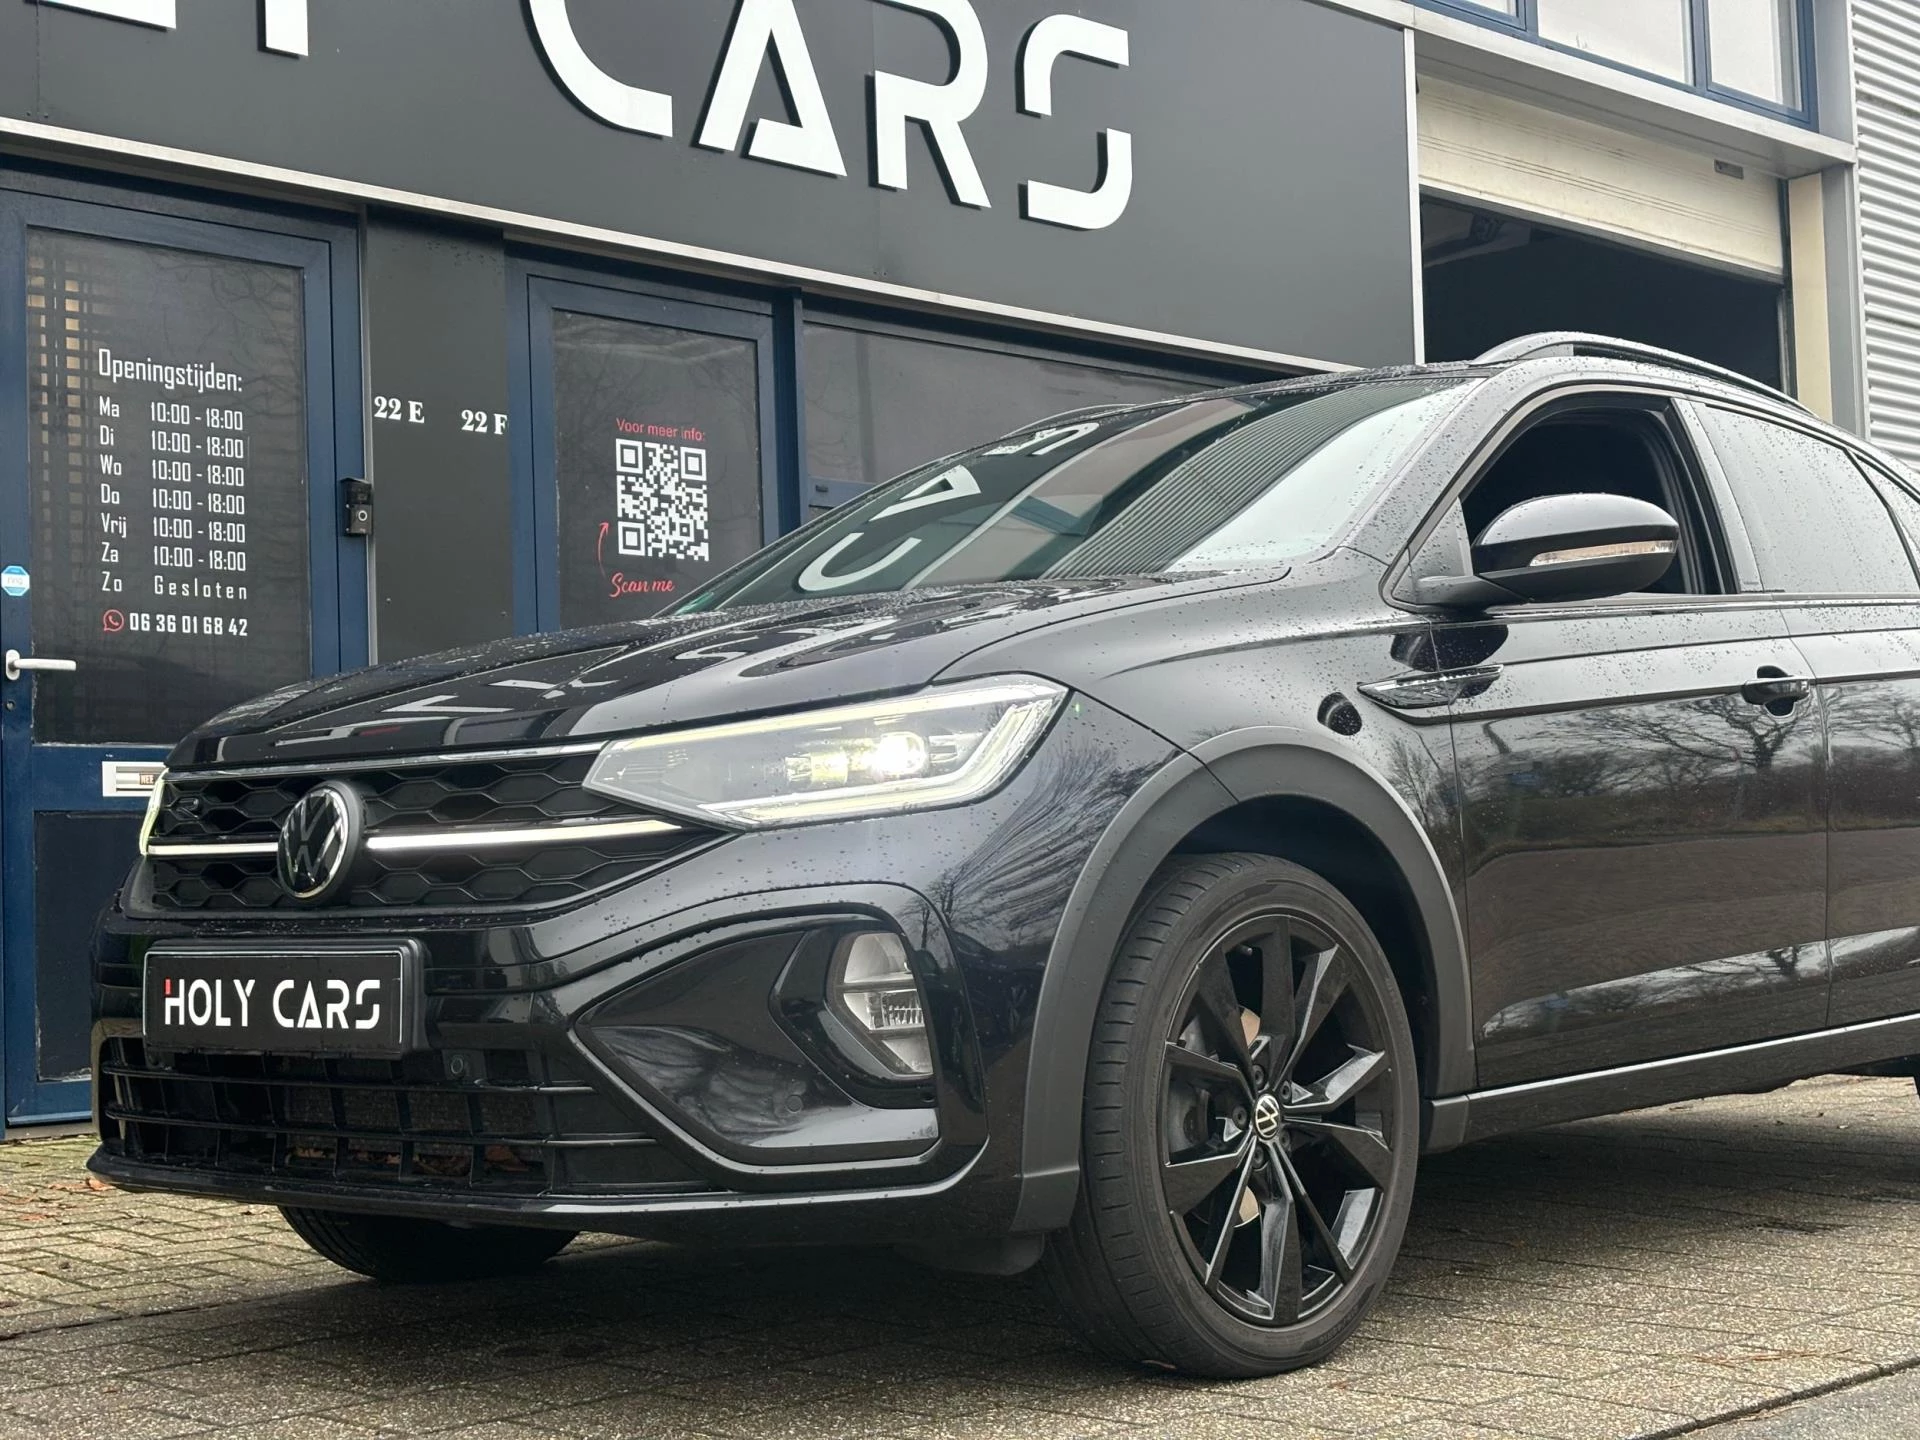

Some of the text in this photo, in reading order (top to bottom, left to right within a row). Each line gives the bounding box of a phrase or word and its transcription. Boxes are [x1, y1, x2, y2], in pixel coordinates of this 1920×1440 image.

[99, 348, 243, 393] Openingstijden:
[100, 396, 120, 418] Ma
[151, 402, 190, 425] 10:00
[206, 408, 243, 431] 18:00
[374, 395, 425, 424] 22 E
[461, 409, 508, 435] 22 F
[100, 425, 114, 446] Di
[152, 430, 191, 453] 10:00
[207, 436, 244, 459] 18:00
[616, 417, 644, 433] Voor
[647, 424, 678, 437] meer
[100, 454, 122, 476] Wo
[152, 459, 191, 482] 10:00
[207, 465, 244, 487] 18:00
[101, 483, 120, 504] Do
[153, 488, 192, 511] 10:00
[208, 493, 245, 515] 18:00
[101, 512, 127, 538] Vrij
[153, 517, 192, 539] 10:00
[209, 521, 246, 543] 18:00
[101, 542, 119, 562] Za
[154, 545, 193, 568] 10:00
[209, 550, 246, 572] 18:00
[102, 571, 247, 599] Zo Gesloten
[609, 572, 675, 598] Scan me
[129, 613, 248, 636] 06 36 01 68 42
[164, 978, 380, 1029] HOLY CARS
